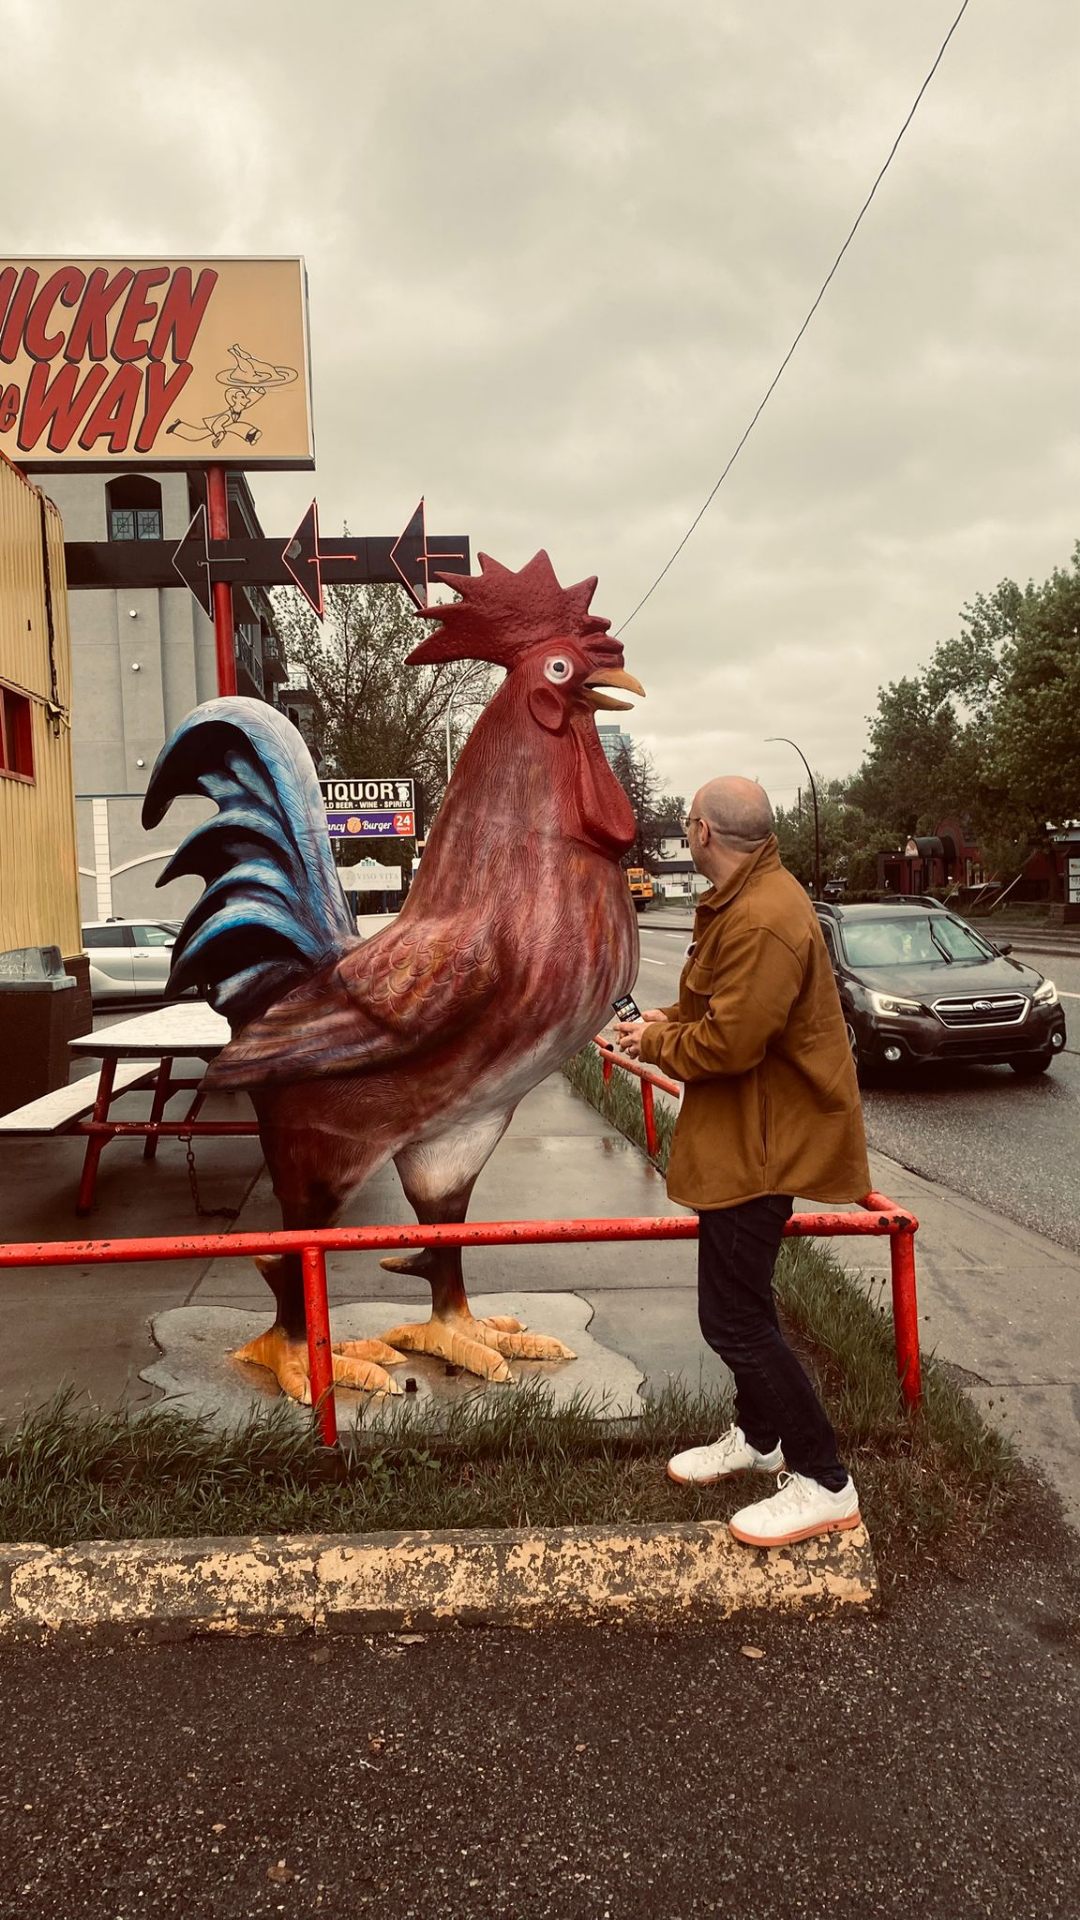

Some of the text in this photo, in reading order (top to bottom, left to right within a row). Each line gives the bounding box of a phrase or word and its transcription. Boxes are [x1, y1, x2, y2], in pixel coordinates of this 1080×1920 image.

[17, 362, 193, 453] WAY
[323, 783, 394, 801] IQUOR
[384, 800, 411, 808] SPIRITS
[362, 820, 392, 832] Burger
[396, 815, 411, 826] 24
